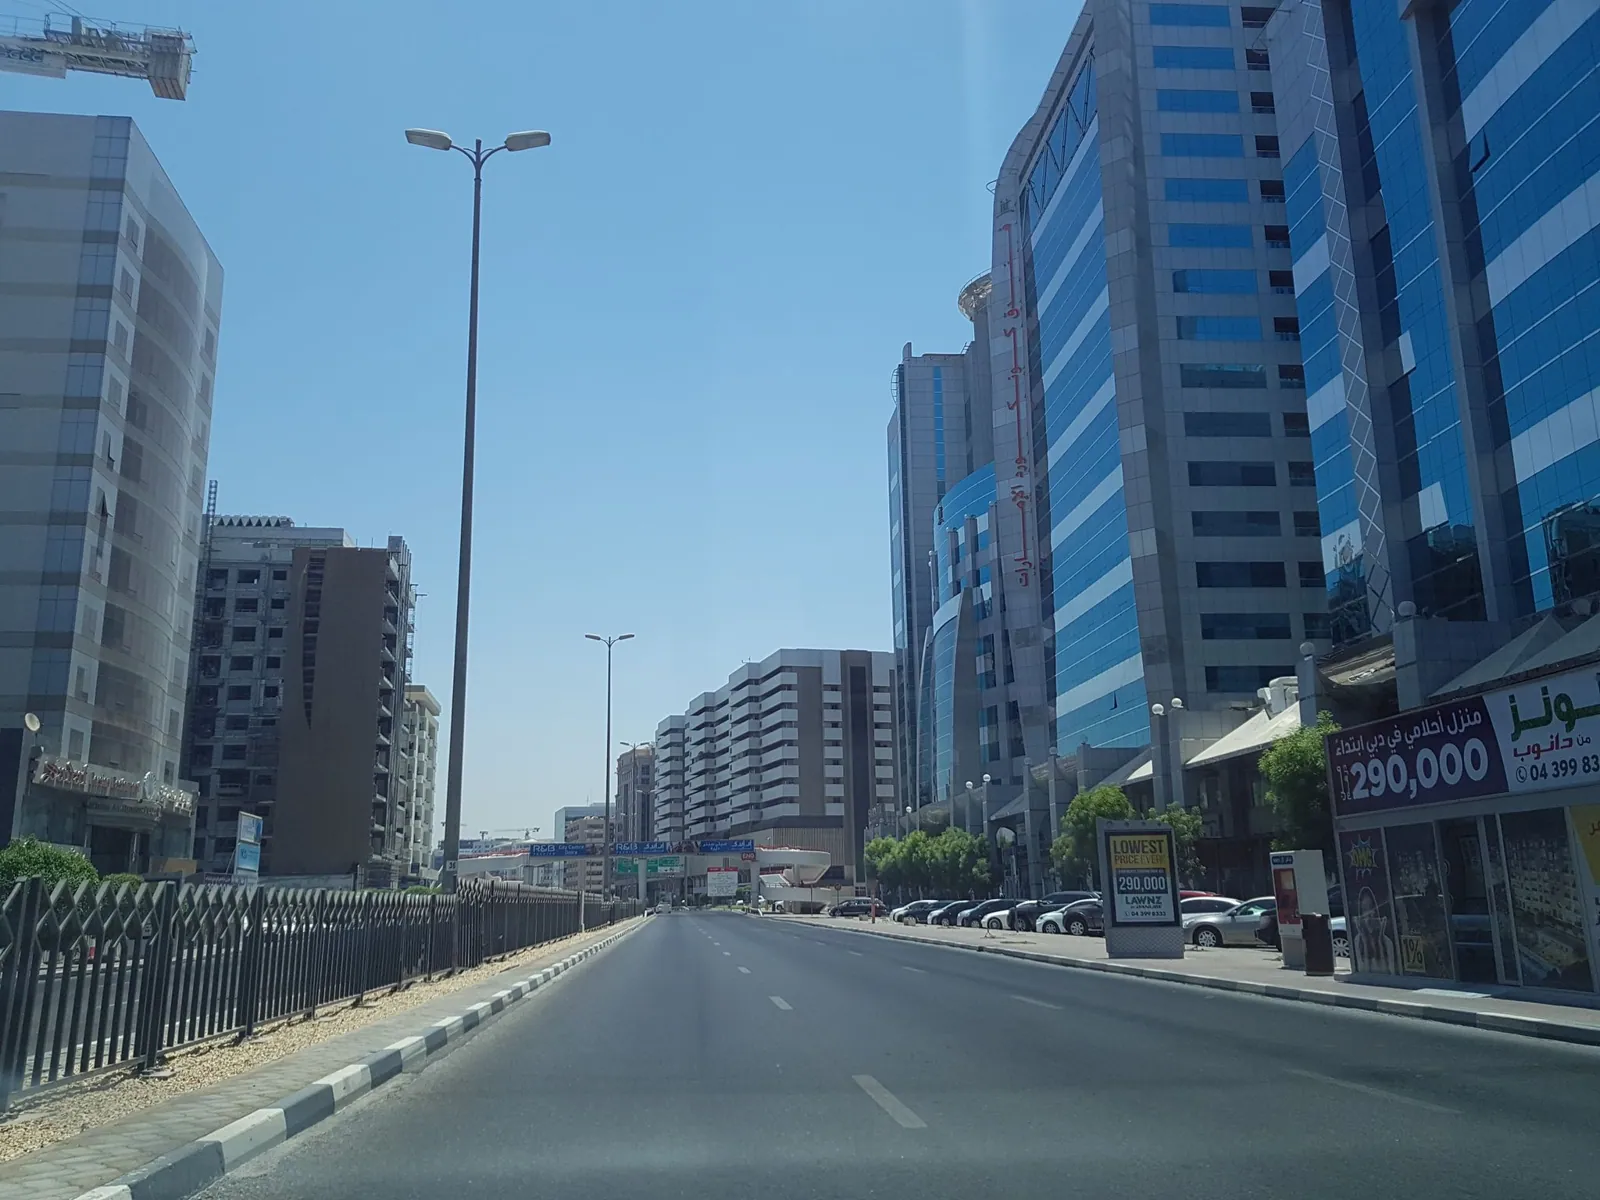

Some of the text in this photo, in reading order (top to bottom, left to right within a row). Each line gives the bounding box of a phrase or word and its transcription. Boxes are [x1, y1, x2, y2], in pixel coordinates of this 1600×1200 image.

[1001, 222, 1020, 319] فندق
[1447, 708, 1482, 735] منزل
[1367, 735, 1386, 759] دبي
[1386, 724, 1402, 754] في
[1576, 734, 1591, 747] من
[1350, 737, 1489, 800] 290,000
[1530, 762, 1548, 782] 04
[1552, 758, 1578, 779] 399
[533, 844, 555, 852] R&B
[616, 842, 638, 851] R&B
[1113, 839, 1164, 854] LOWEST
[1114, 855, 1139, 865] PRICE
[1118, 876, 1166, 892] 290,000
[1125, 895, 1163, 905] LAWNZ
